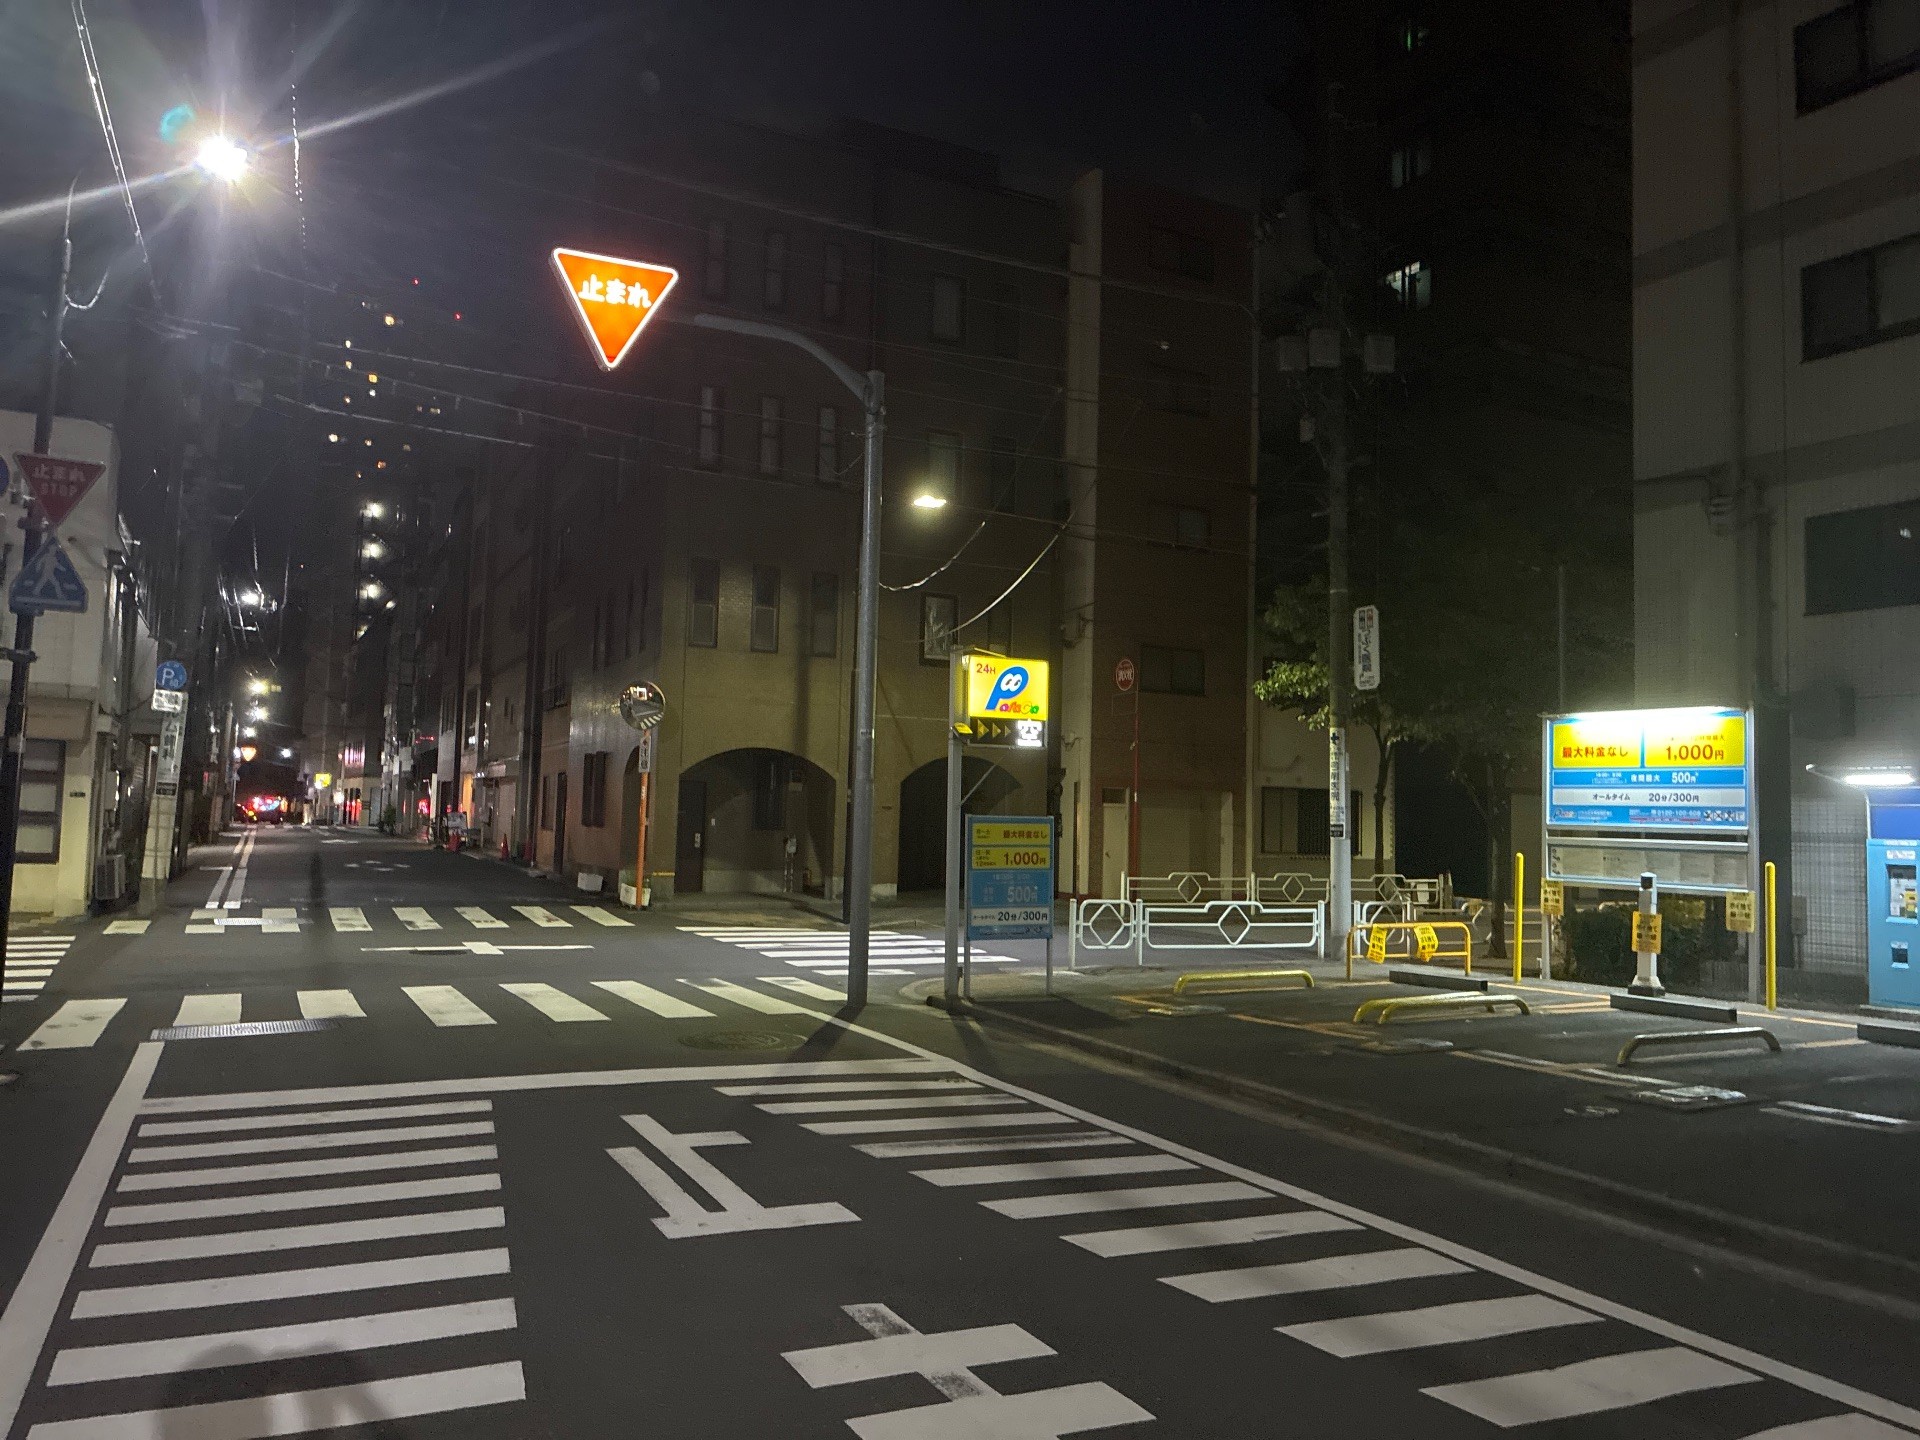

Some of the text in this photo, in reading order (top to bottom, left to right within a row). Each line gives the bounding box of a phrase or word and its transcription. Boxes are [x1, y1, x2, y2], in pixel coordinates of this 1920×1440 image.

[578, 273, 652, 309] 止まれ
[32, 463, 86, 482] 止まれ
[41, 482, 77, 497] STOP
[976, 663, 996, 674] 24H
[1017, 717, 1043, 747] 空
[1562, 746, 1628, 759] 最大料金なし
[1666, 744, 1724, 761] 1,000円
[1631, 774, 1660, 783] 夜間最大
[1592, 793, 1699, 803] オールタイム 20分/300円
[1003, 829, 1047, 839] 最大料金なし
[1003, 852, 1046, 866] 1,000円
[998, 911, 1047, 921] 20分/300円
